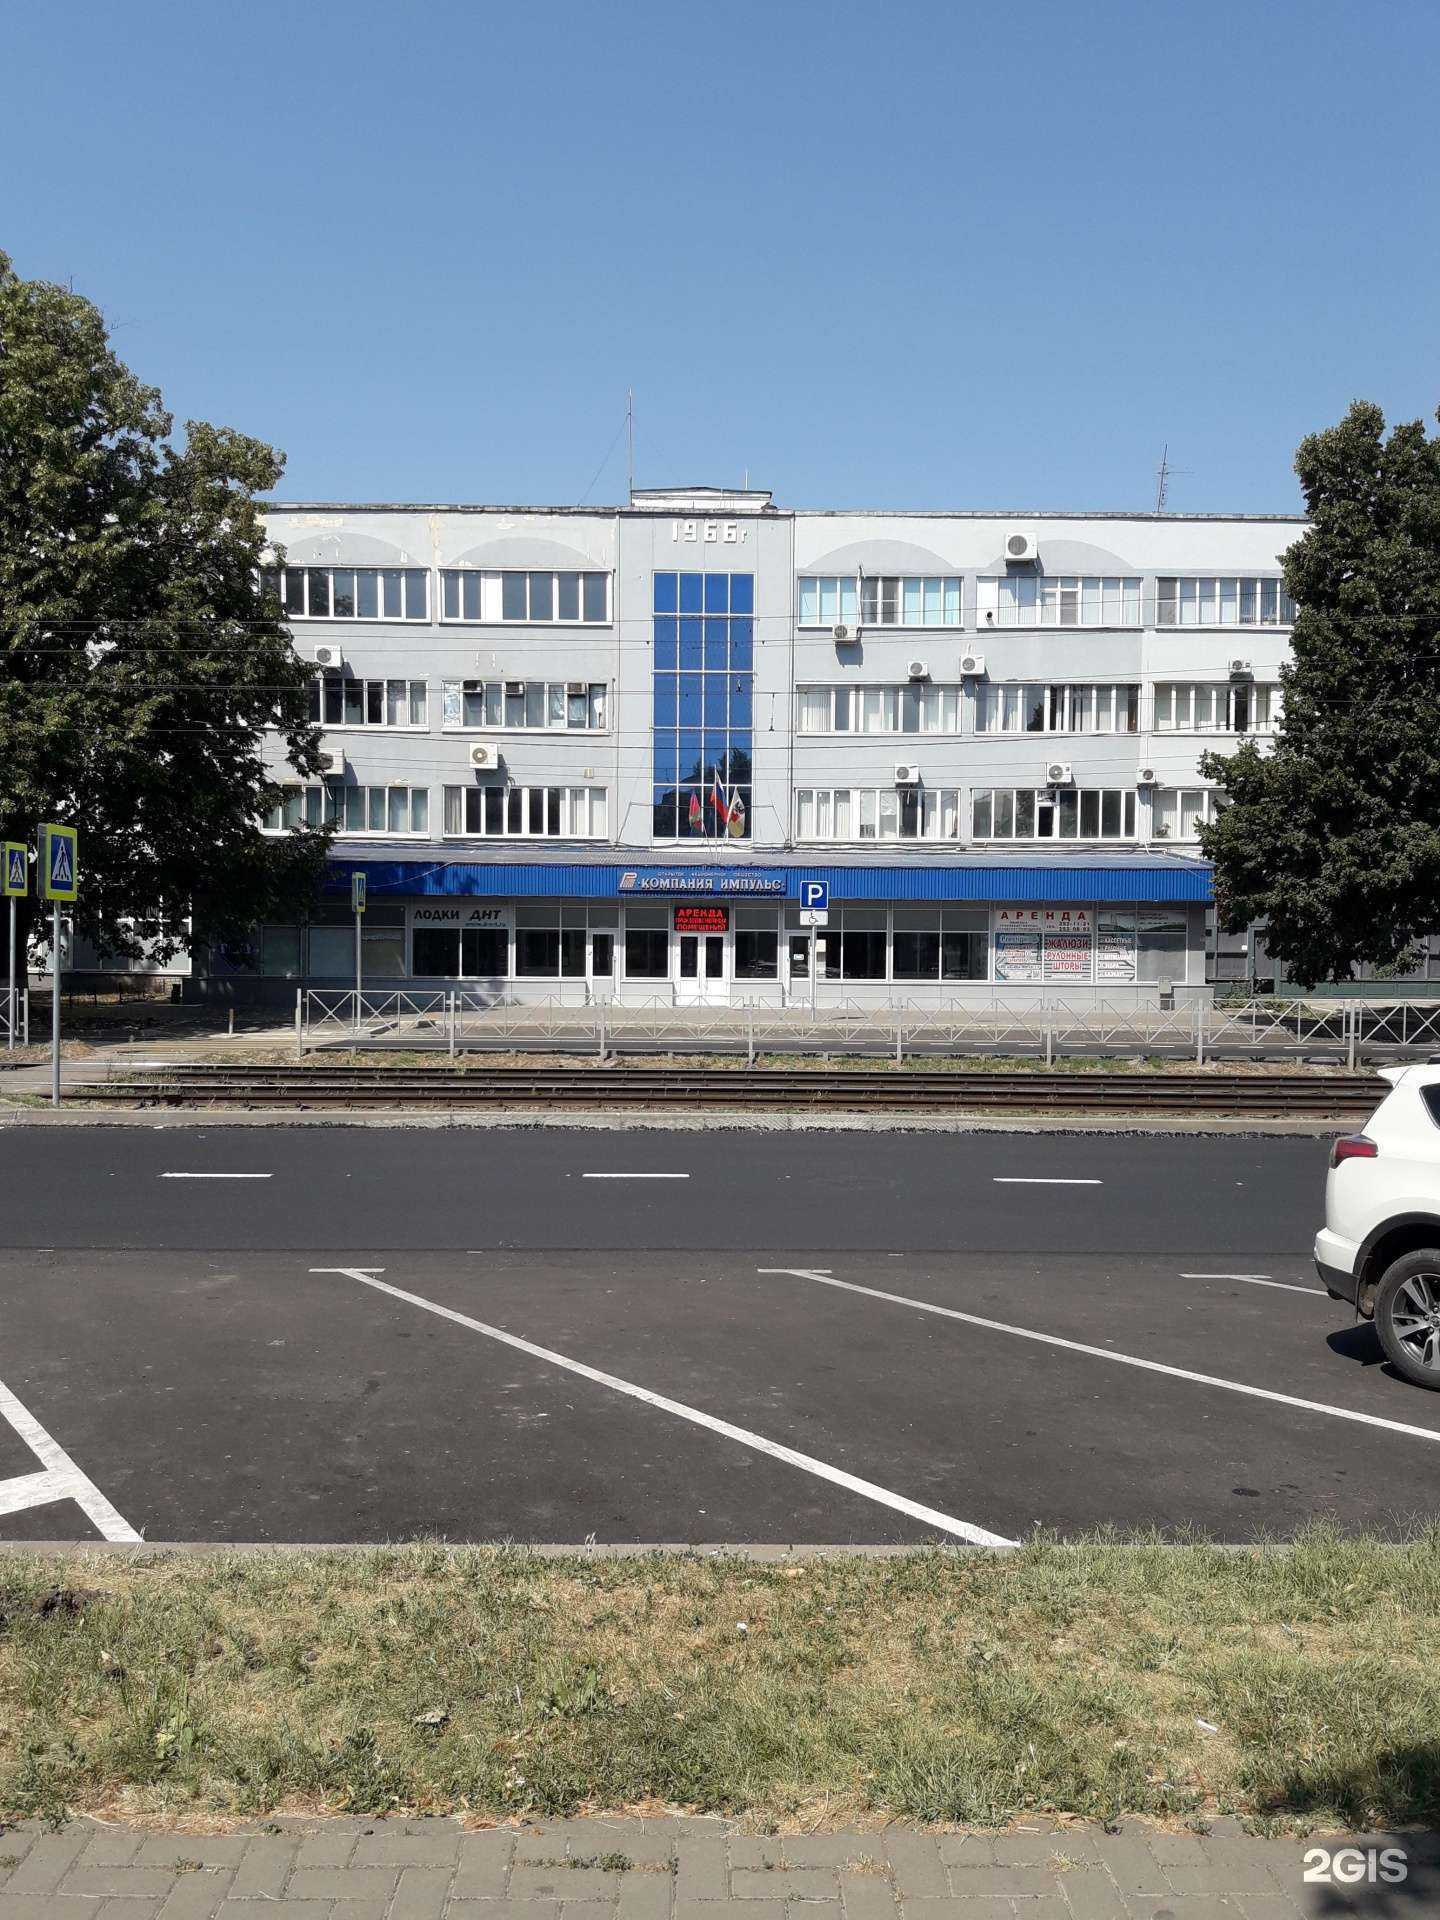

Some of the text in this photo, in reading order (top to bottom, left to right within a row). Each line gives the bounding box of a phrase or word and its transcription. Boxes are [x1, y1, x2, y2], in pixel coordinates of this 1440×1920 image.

[641, 878, 782, 891] КОМПАНИЯ ИМПУЛЬС
[807, 884, 823, 906] P
[414, 909, 502, 921] ЛОДКИ ДНТ
[678, 908, 723, 918] АРЕНДА
[1000, 911, 1086, 922] АРЕНДА
[1047, 939, 1088, 949] ЖАЛЮЗИ
[1046, 951, 1089, 960] РУЛОННЫЕ
[1052, 961, 1083, 970] ШТОРЫ
